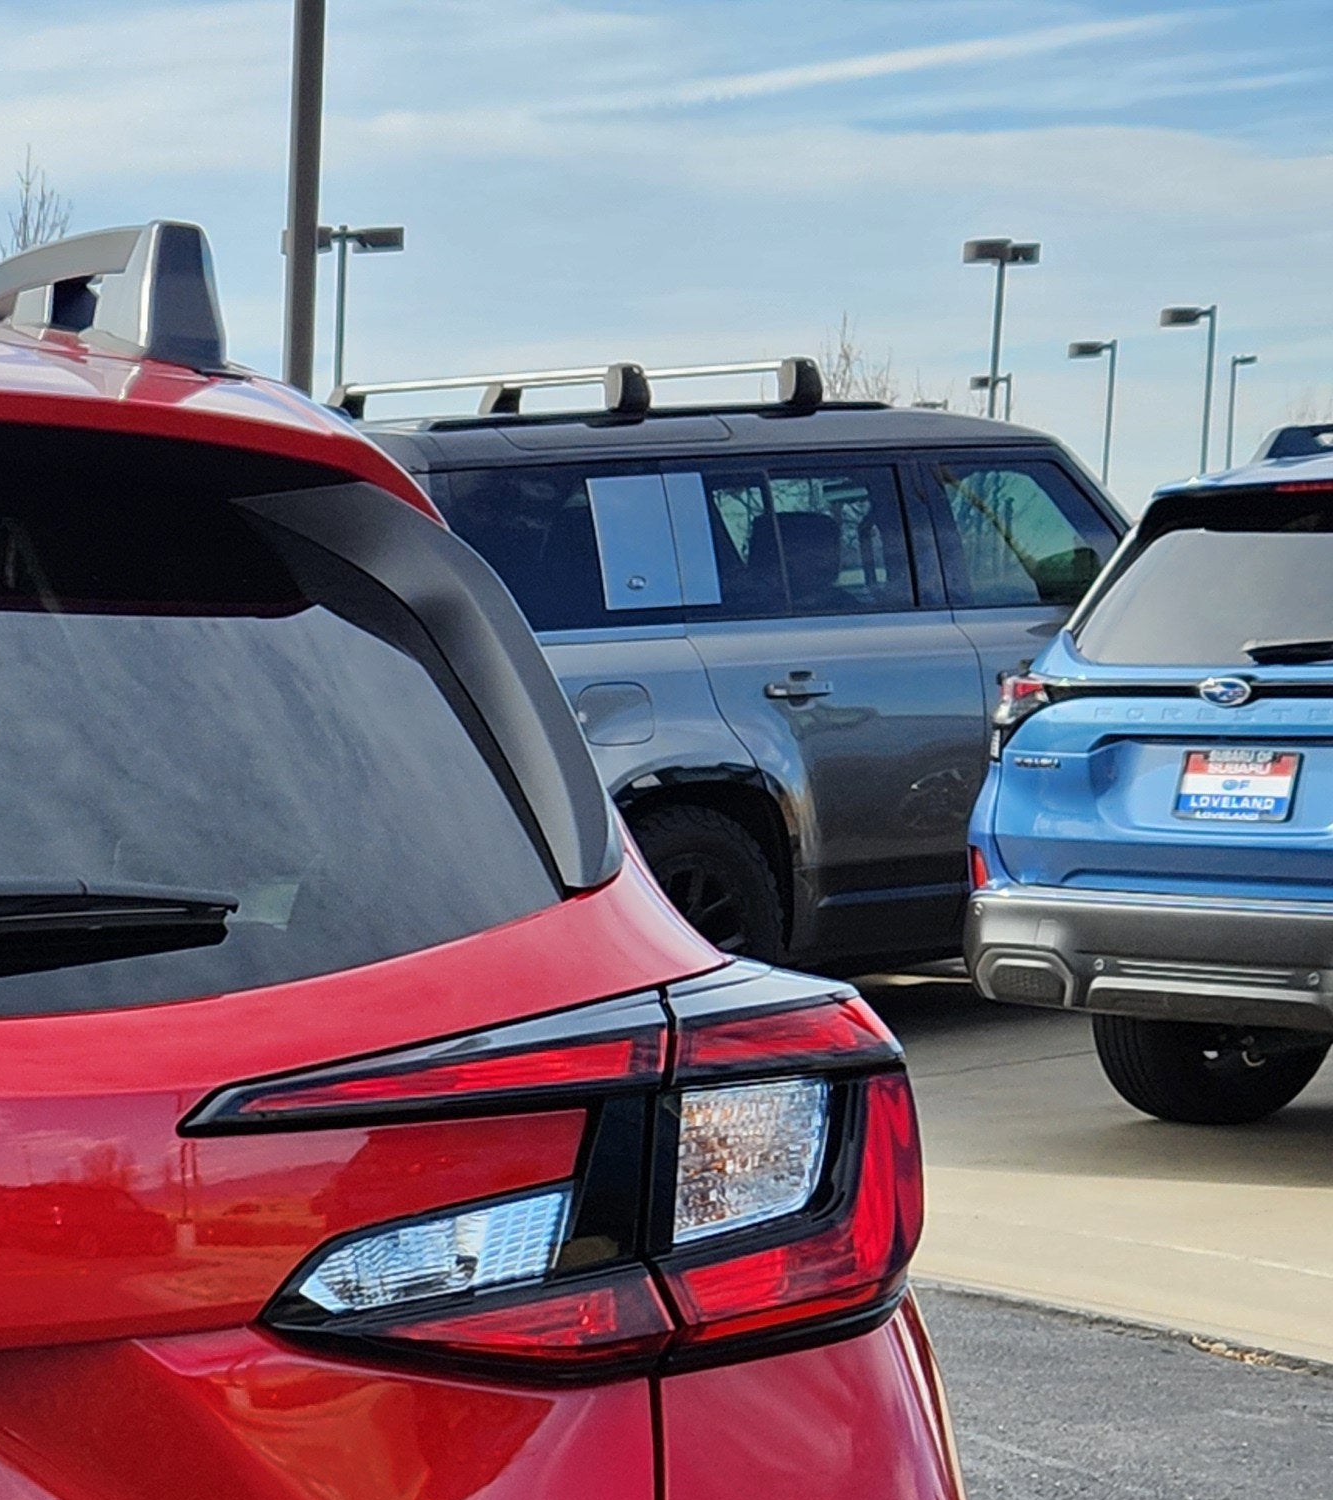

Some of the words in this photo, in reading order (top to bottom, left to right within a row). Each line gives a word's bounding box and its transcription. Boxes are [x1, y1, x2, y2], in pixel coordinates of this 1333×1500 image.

[1208, 762, 1272, 775] SUBARU
[1190, 795, 1276, 810] LOVELAND
[1194, 810, 1260, 821] LOVELAND
